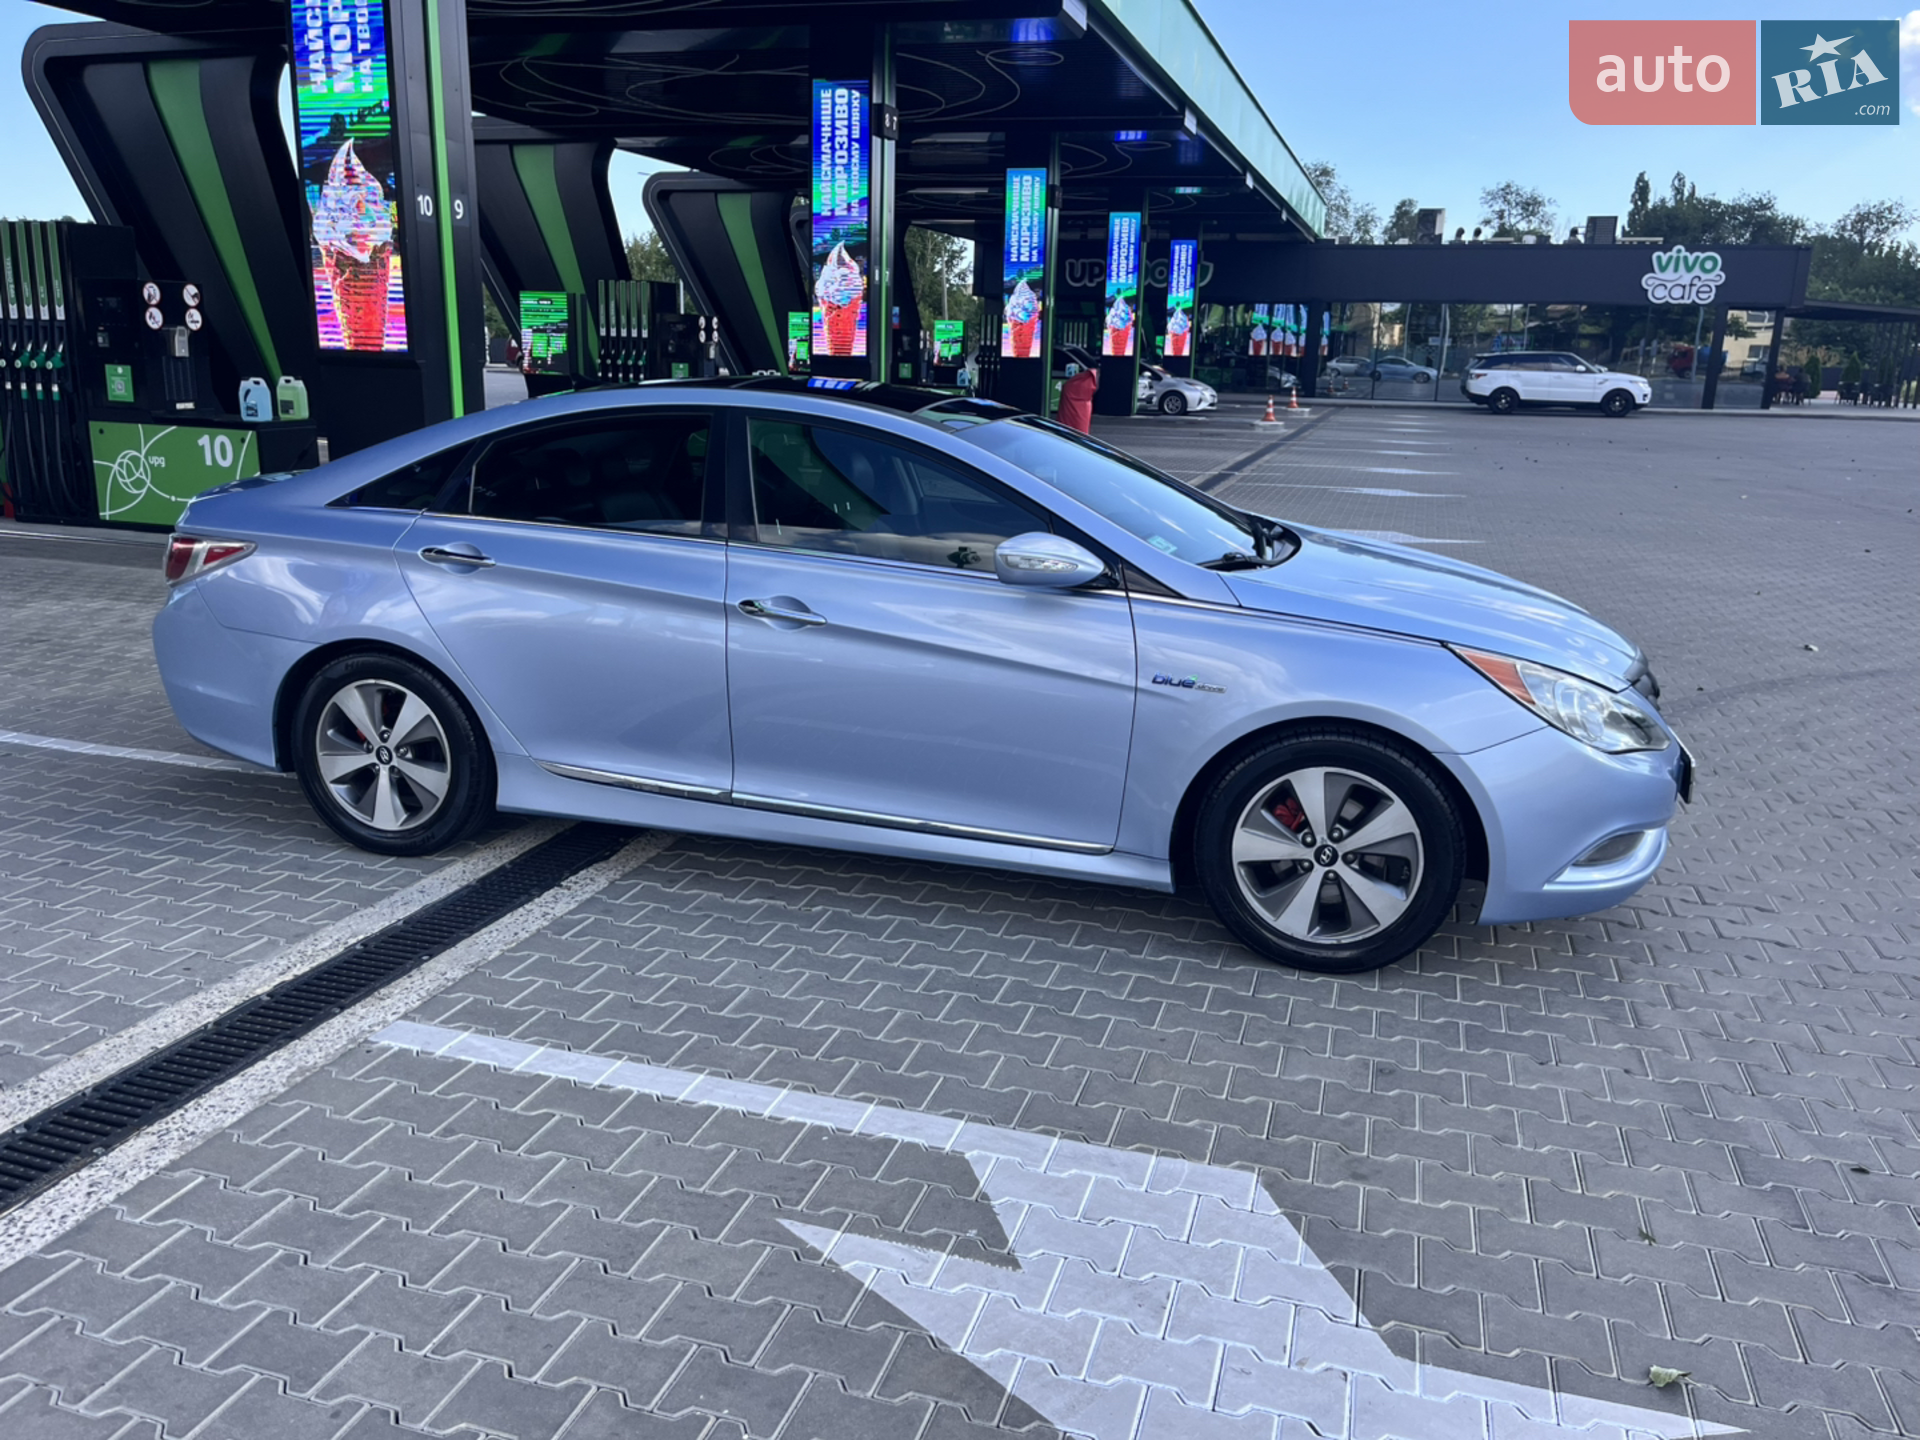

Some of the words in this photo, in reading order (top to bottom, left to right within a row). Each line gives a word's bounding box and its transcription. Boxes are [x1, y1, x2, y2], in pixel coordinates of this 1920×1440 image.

[359, 58, 373, 93] НА
[851, 89, 860, 139] ШЛЯХУ
[820, 88, 832, 216] НАЙСМАЧНІШЕ
[834, 88, 849, 216] МОРОЗИВО
[416, 194, 433, 217] 10
[454, 199, 464, 220] 9
[851, 199, 859, 216] НА
[1020, 175, 1033, 262] МОРОЗИВО
[1118, 217, 1130, 283] МОРОЗИВО
[1656, 248, 1719, 274] vivo
[1651, 275, 1713, 301] cafe
[148, 455, 165, 467] upg
[197, 435, 234, 467] 10
[1152, 671, 1196, 689] blue
